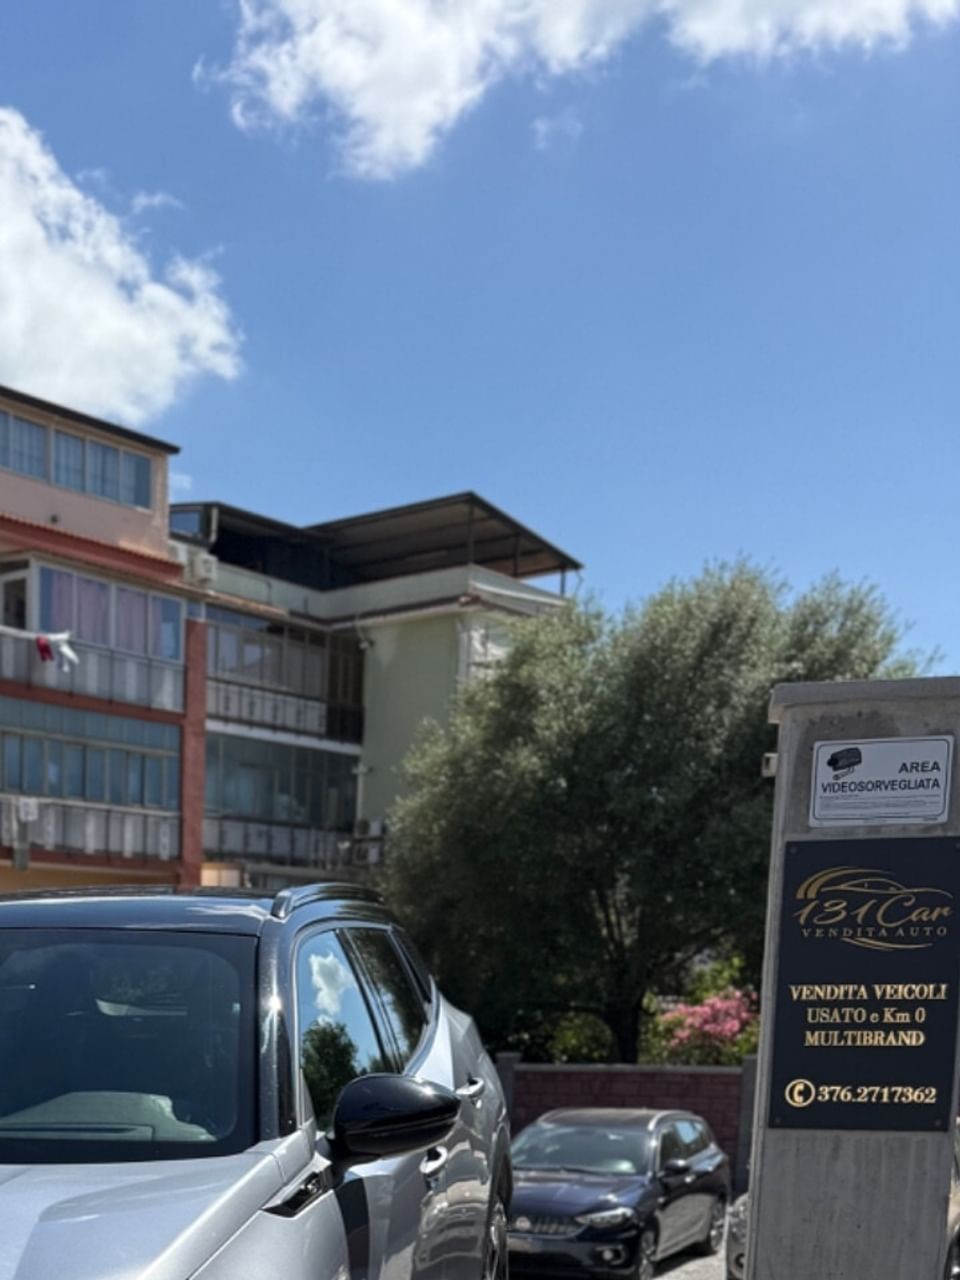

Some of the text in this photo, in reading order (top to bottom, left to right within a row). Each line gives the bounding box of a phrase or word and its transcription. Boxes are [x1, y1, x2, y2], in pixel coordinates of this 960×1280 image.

[898, 761, 941, 774] AREA
[821, 778, 941, 793] VIDEOSORVEGLIATA
[801, 926, 947, 937] VENDITA AUTO
[789, 983, 949, 1000] VENDITA VEICOLI
[807, 1007, 866, 1024] USATO
[869, 1012, 880, 1024] e
[883, 1007, 911, 1024] Km
[804, 1030, 926, 1046] MULTIBRAND
[817, 1085, 937, 1103] 376.2717362
